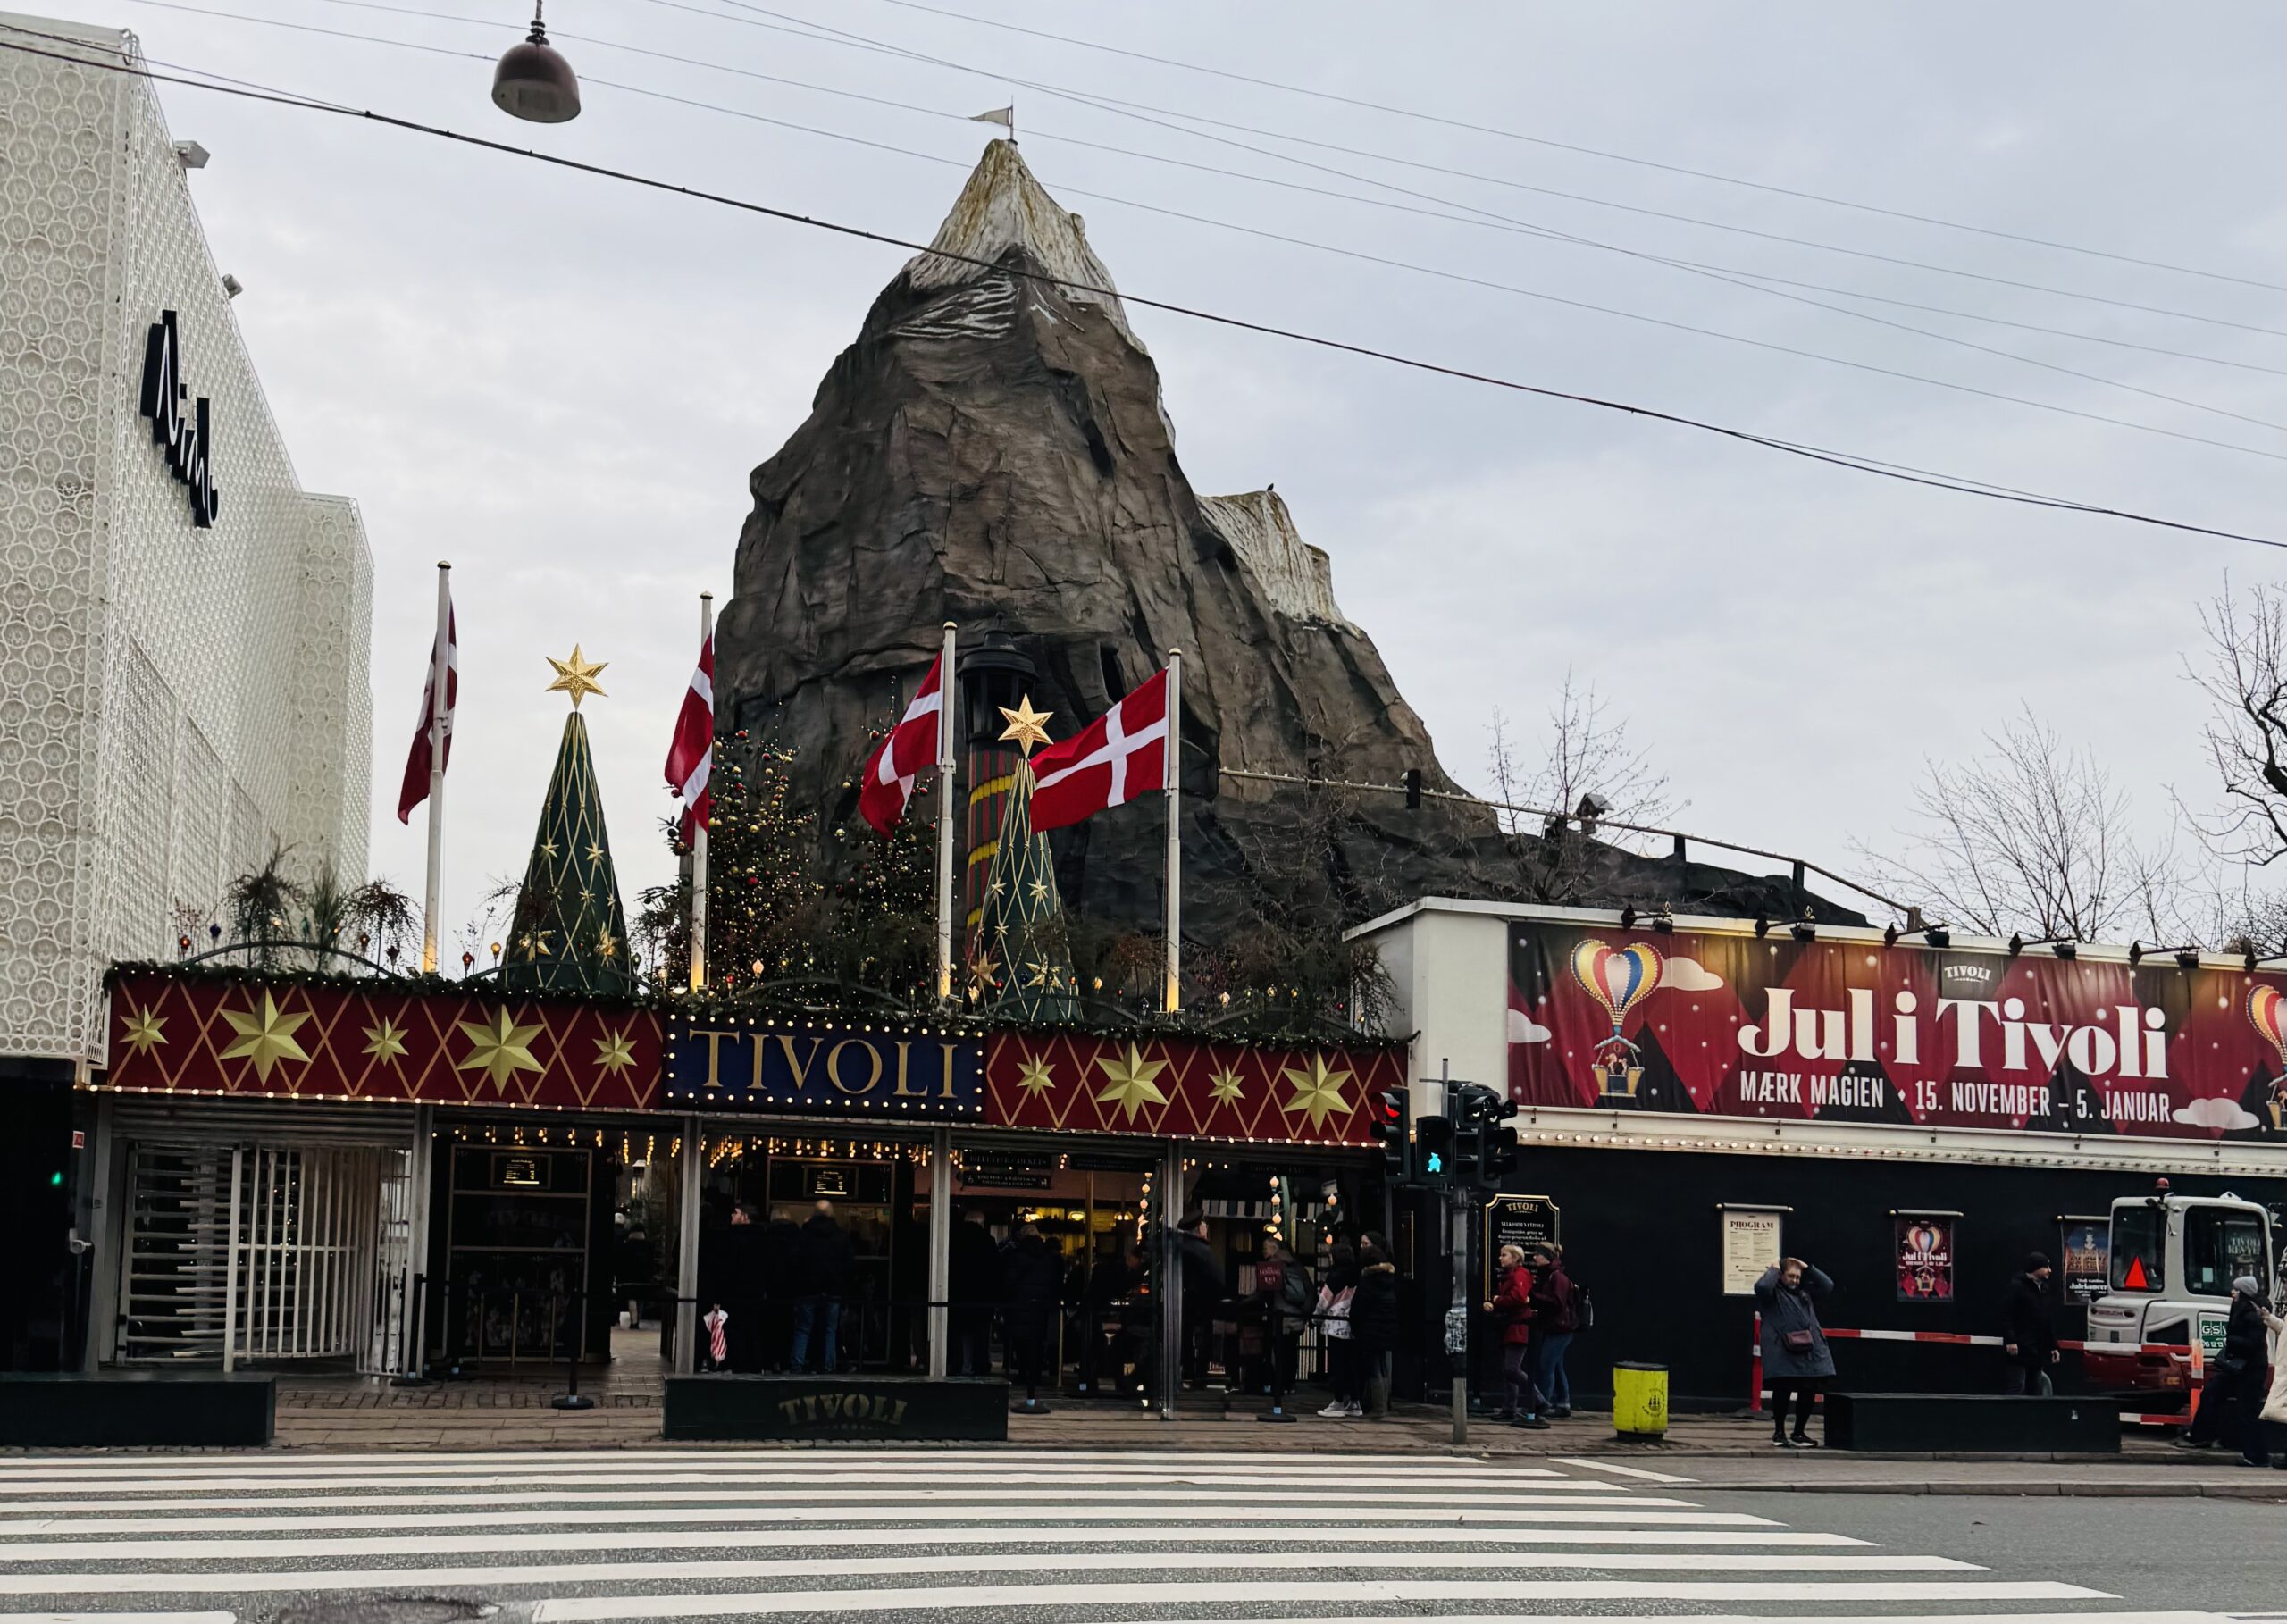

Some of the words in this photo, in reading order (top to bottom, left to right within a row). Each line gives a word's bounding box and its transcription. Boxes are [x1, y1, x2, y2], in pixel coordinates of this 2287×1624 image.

[1944, 965, 1992, 981] TIVOLI
[1737, 986, 1879, 1062] Jul
[1892, 990, 1921, 1065] i
[1935, 996, 2170, 1079] Tivoli
[689, 1028, 958, 1098] TIVOLI
[1739, 1070, 1803, 1104] MÆRK
[1810, 1075, 1885, 1109] MAGIEN
[1914, 1080, 1944, 1112] 15.
[1951, 1083, 2051, 1117] NOVEMBER
[2076, 1089, 2094, 1119] 5.
[2100, 1090, 2172, 1123] JANUAR
[1505, 1202, 1538, 1213] TIVOLI
[1730, 1220, 1774, 1229] PROGRAM
[777, 1392, 909, 1426] TIVOLI
